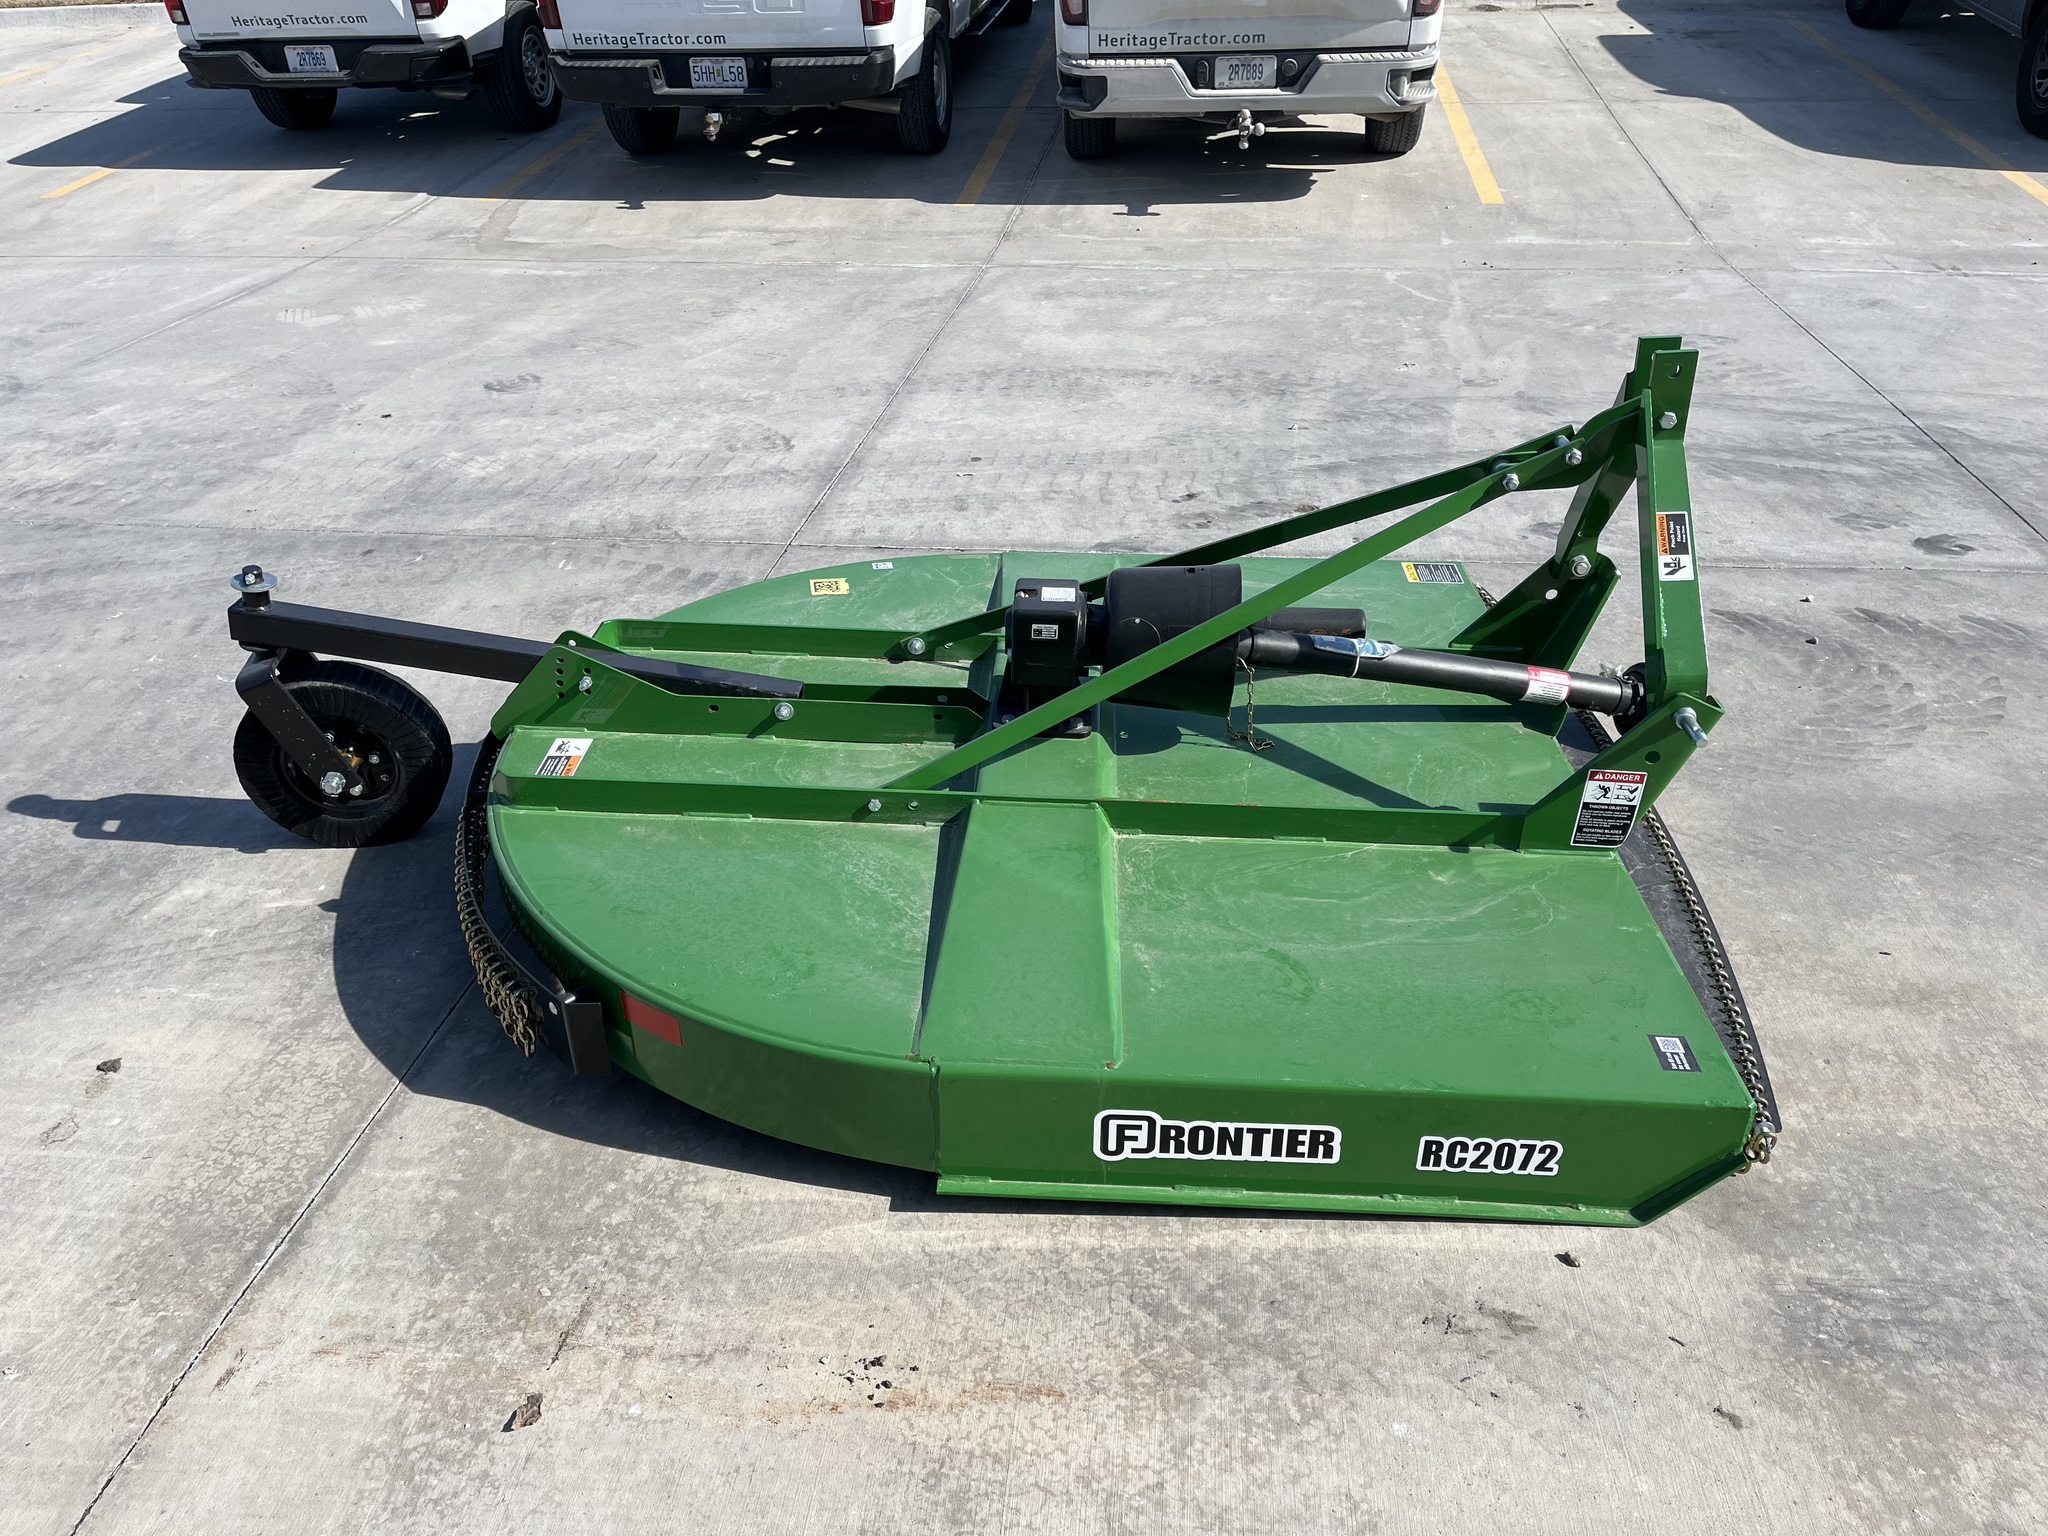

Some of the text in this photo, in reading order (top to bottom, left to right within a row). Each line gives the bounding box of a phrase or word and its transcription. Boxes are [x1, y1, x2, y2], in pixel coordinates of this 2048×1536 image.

[231, 14, 368, 29] HeritageTractor.com
[572, 32, 727, 49] HeritageTractor.com
[1098, 32, 1266, 50] HeritageTractor.com
[692, 65, 745, 83] 5HH L58
[1228, 62, 1264, 82] 2R7B89
[1658, 516, 1668, 548] WARNING
[1604, 773, 1641, 782] DANGER
[1097, 1112, 1561, 1174] FRONTIER RC2072
